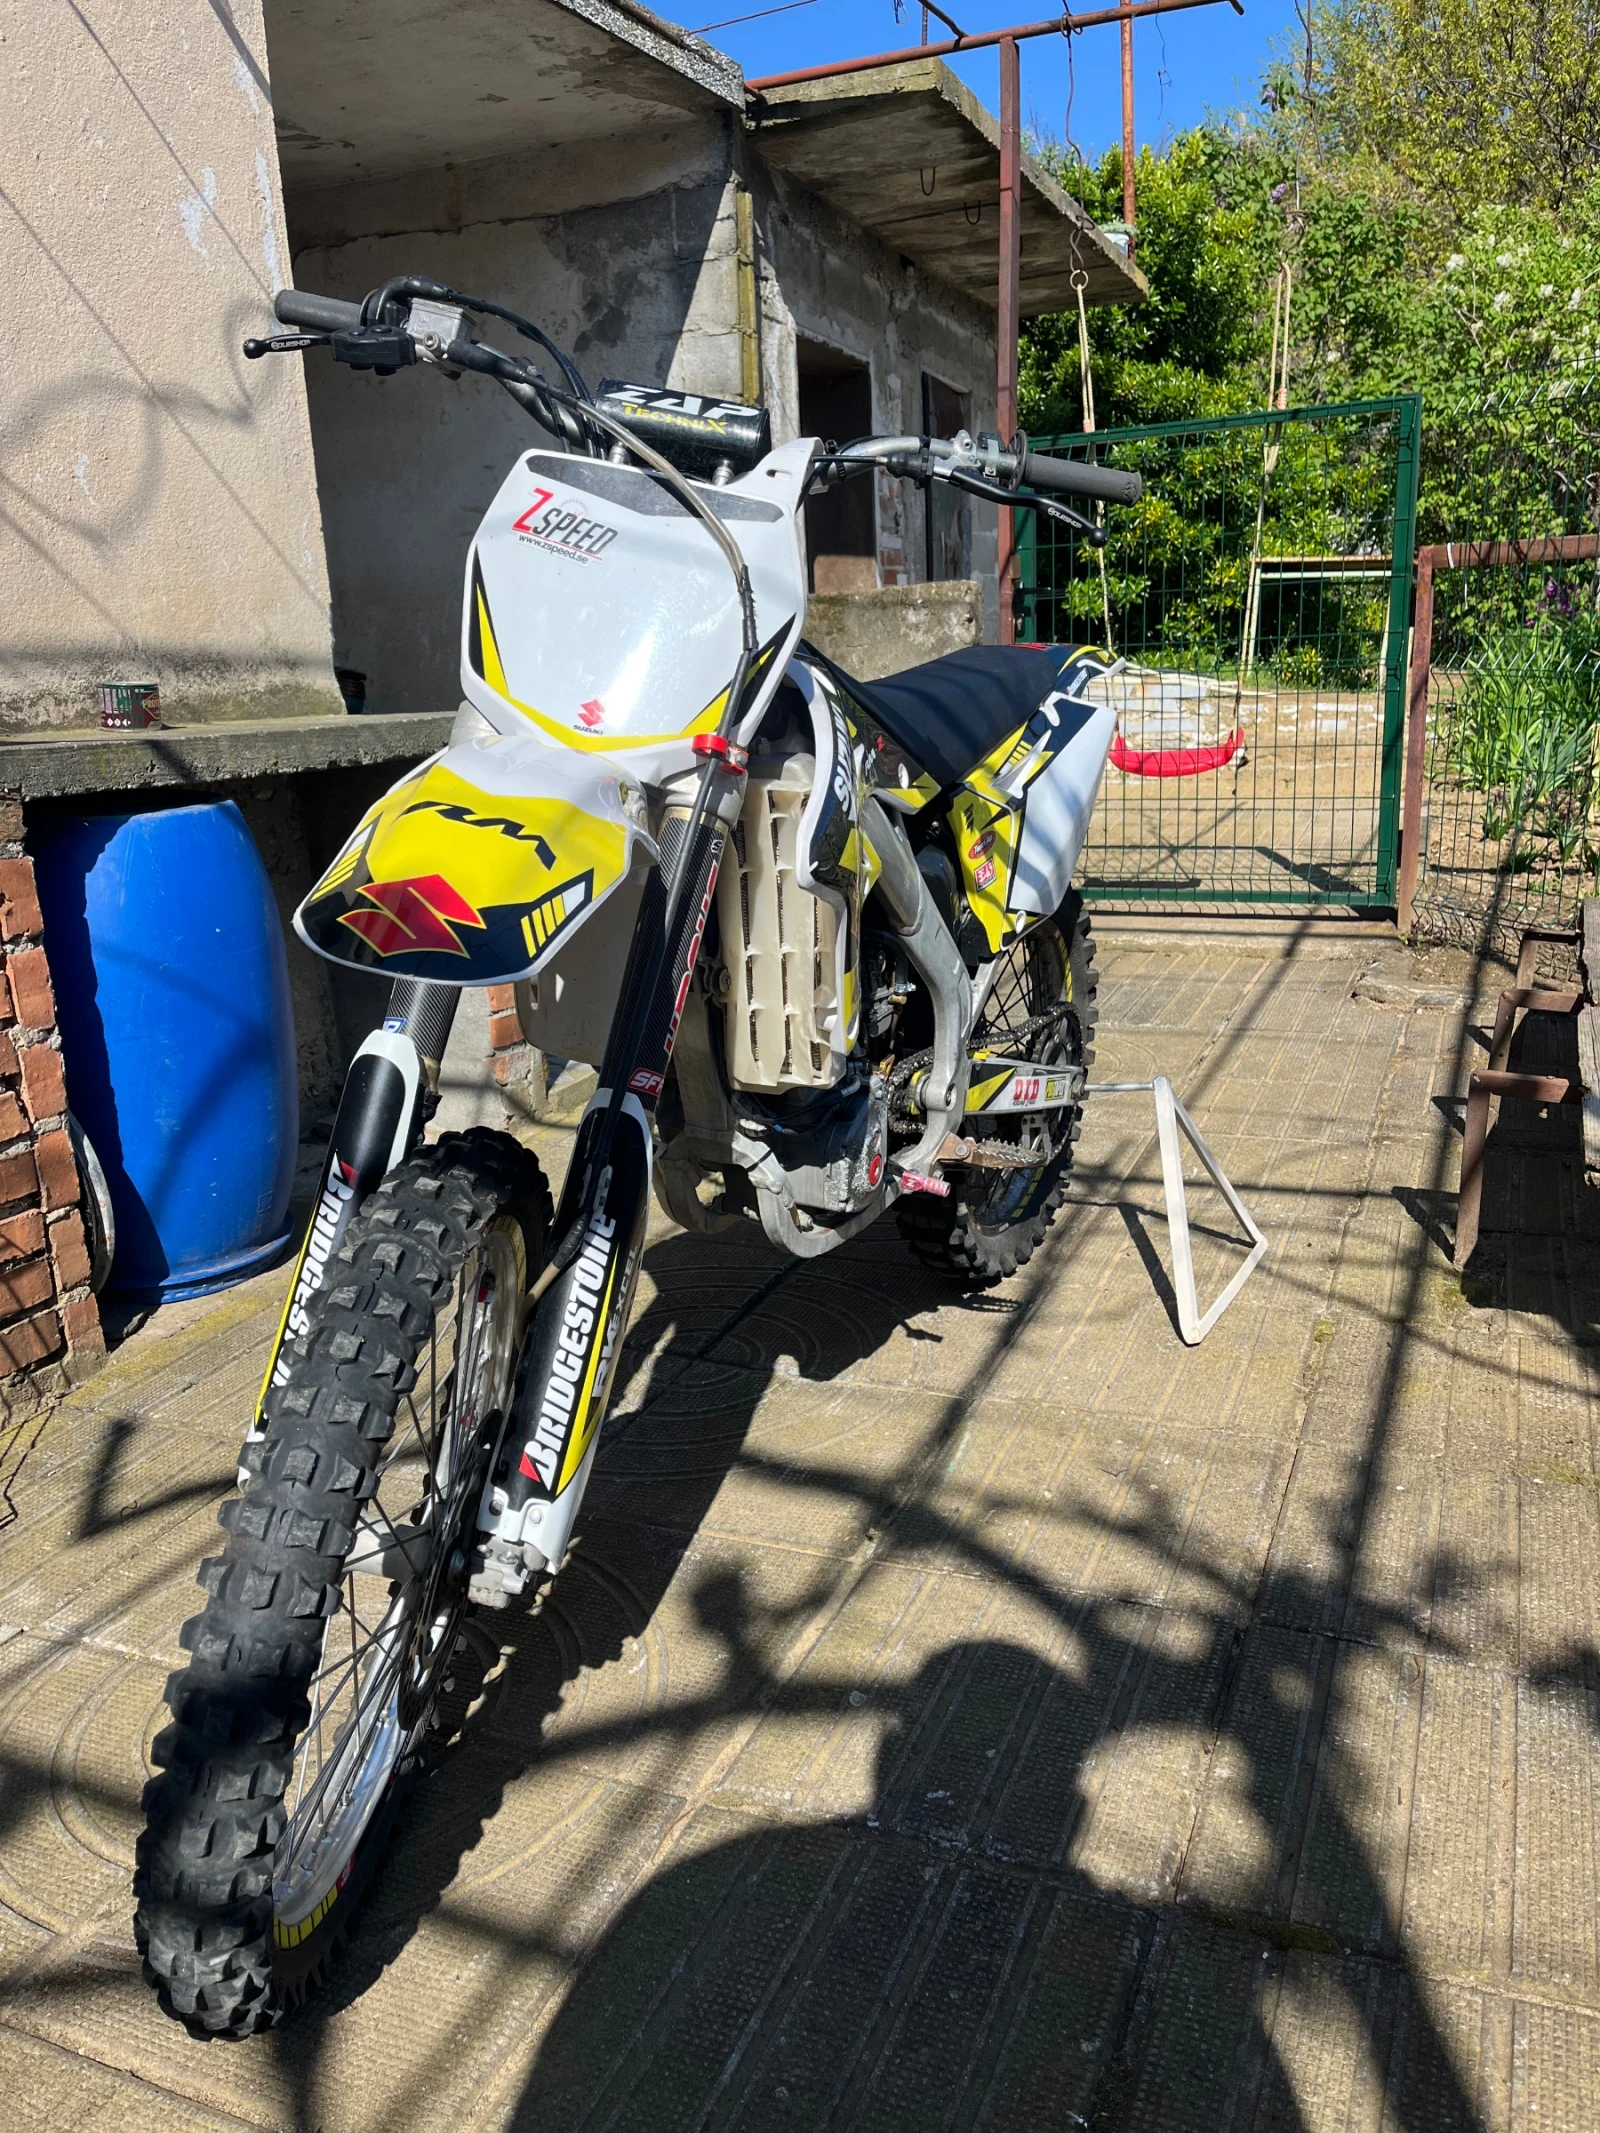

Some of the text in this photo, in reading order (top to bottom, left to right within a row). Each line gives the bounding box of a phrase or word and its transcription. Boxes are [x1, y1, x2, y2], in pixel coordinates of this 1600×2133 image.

[604, 384, 760, 419] ZAP
[621, 402, 728, 435] TECHNIX
[518, 534, 589, 564] www.zspeed.se
[573, 724, 604, 736] SUZUKI
[611, 1245, 637, 1323] EXCEL
[524, 1212, 617, 1491] BRIDGESTONE
